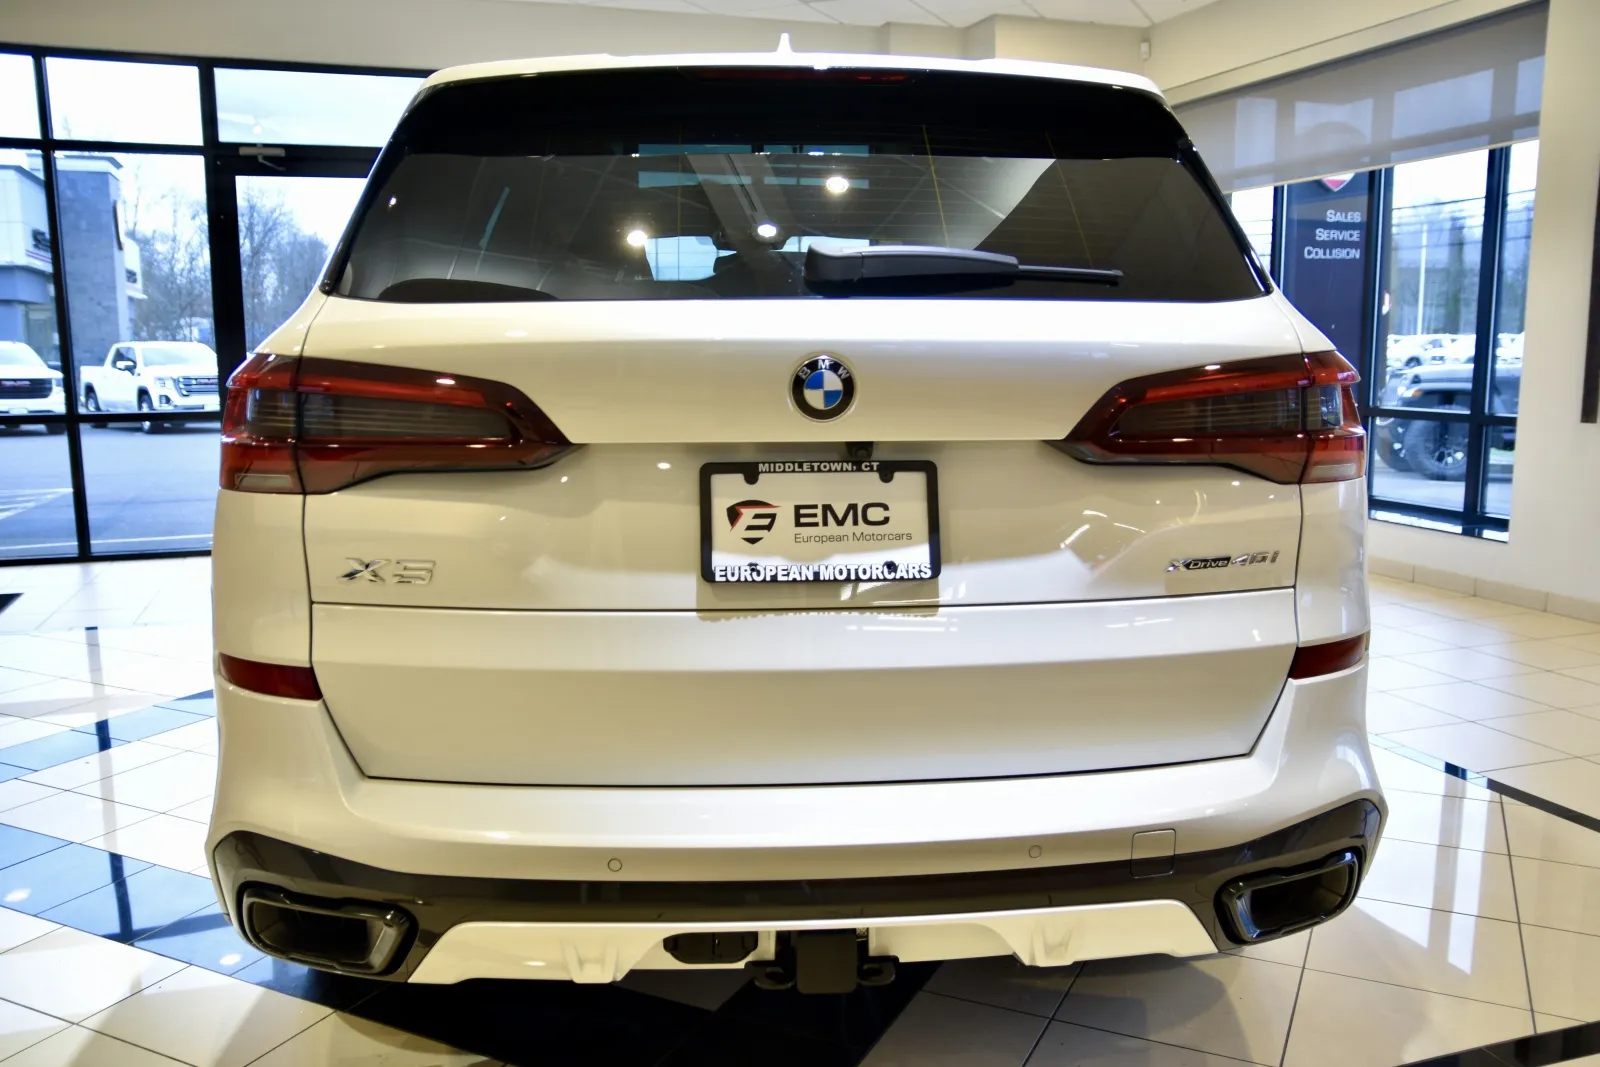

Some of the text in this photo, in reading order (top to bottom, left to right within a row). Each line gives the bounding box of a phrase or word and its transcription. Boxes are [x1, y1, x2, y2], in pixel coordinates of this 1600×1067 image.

[1326, 209, 1361, 222] SALES
[1315, 228, 1360, 241] SERVICE
[1303, 246, 1360, 259] COLLISION
[798, 359, 850, 380] BMW
[758, 461, 880, 472] MIDDLETOWN, CT
[794, 502, 890, 527] EMC
[794, 531, 913, 544] European Motorcars
[336, 557, 436, 584] X5
[714, 563, 932, 581] EUROPEAN MOTORCARS
